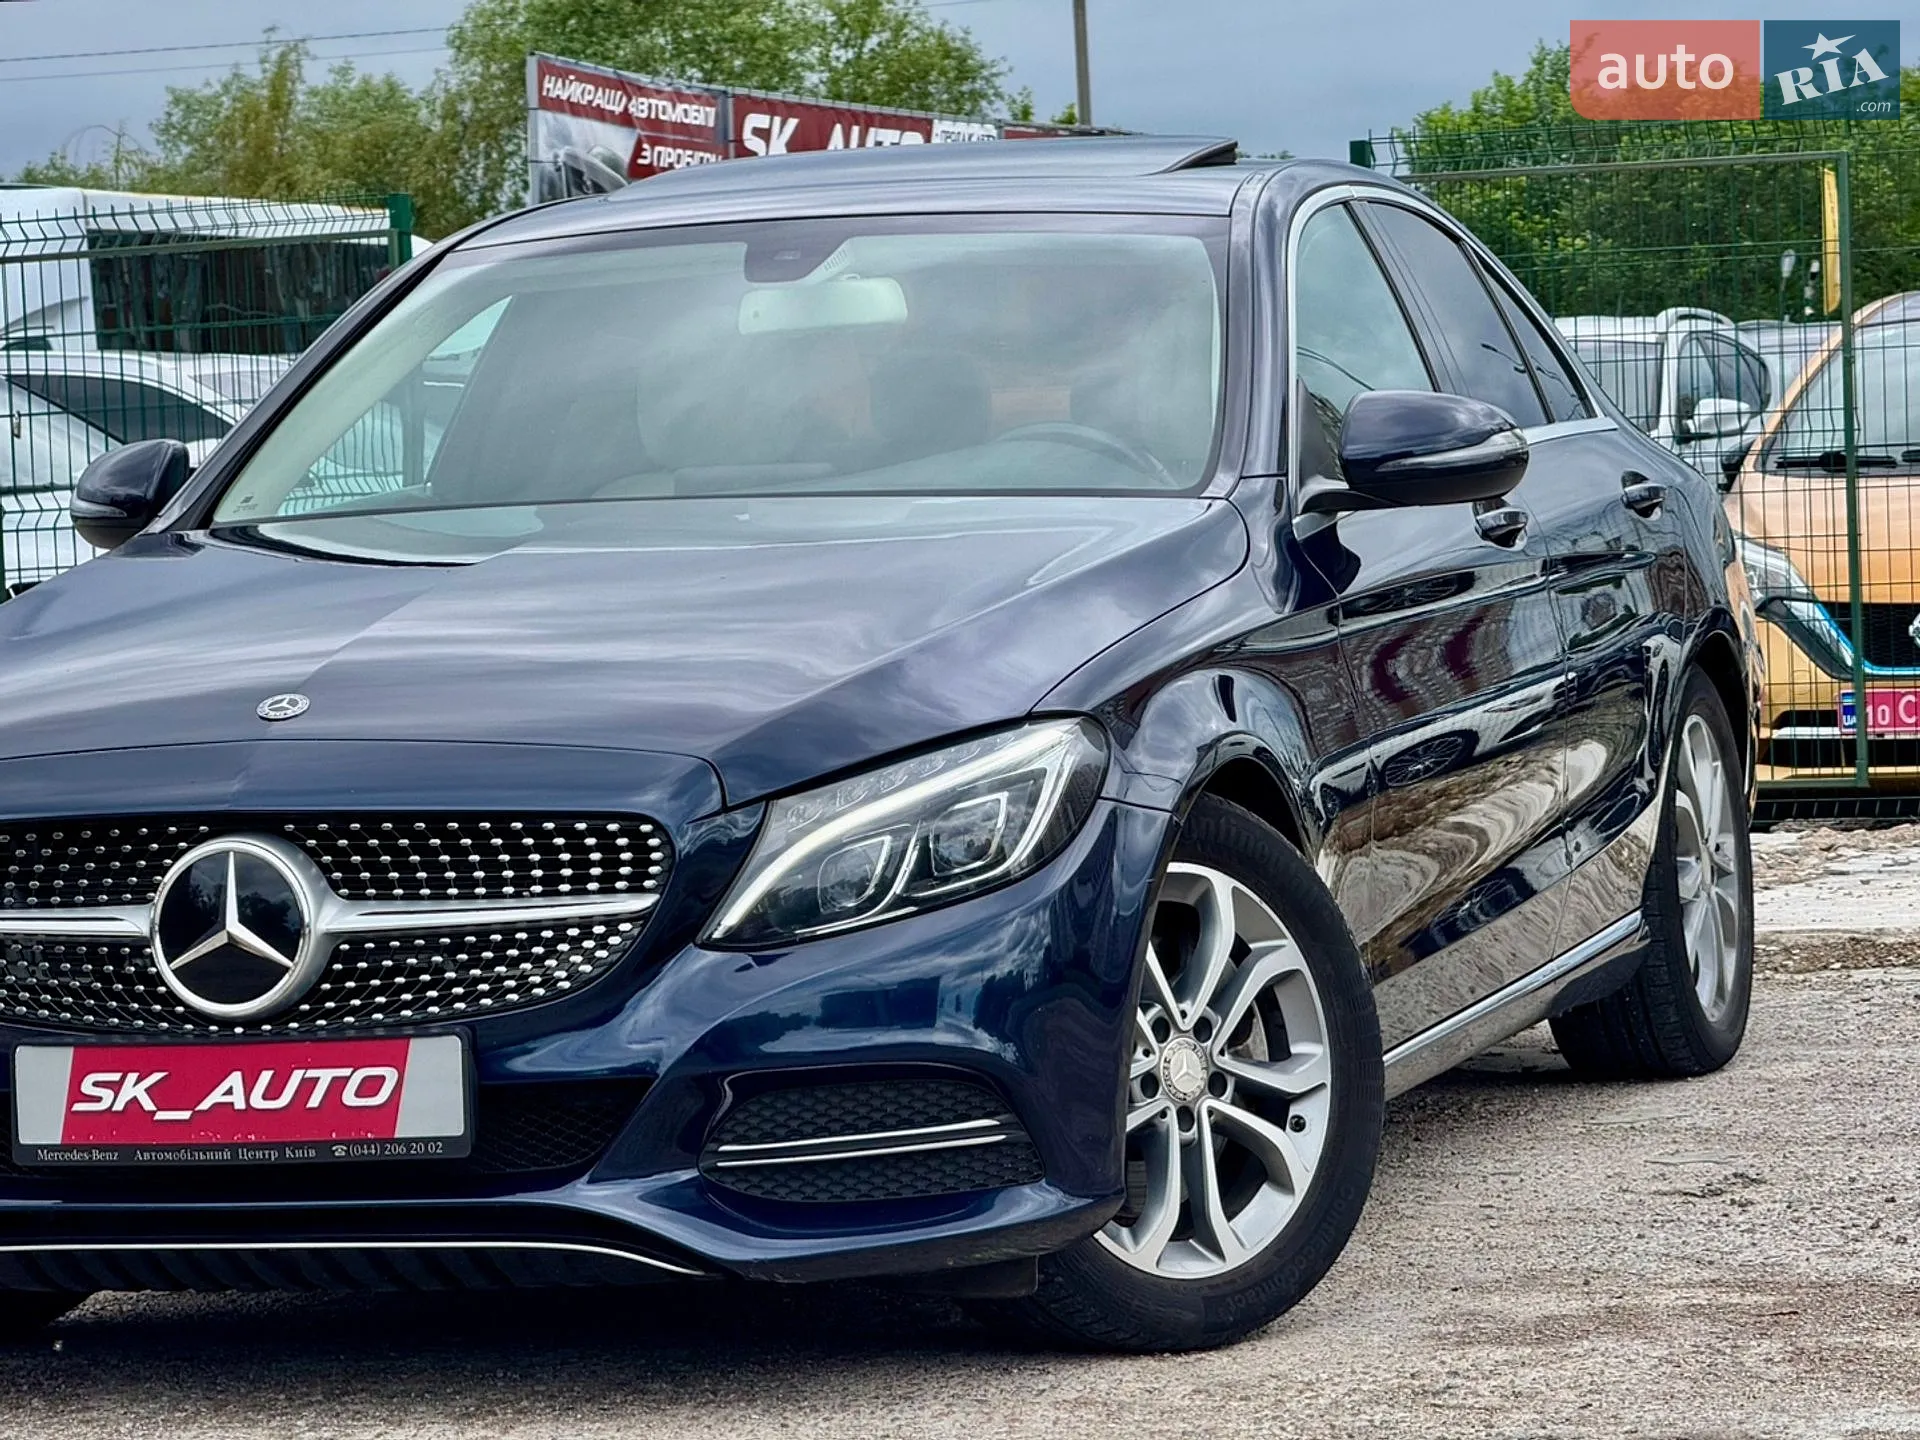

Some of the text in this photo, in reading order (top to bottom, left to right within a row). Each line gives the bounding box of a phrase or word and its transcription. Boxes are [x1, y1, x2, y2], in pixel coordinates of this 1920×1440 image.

[542, 75, 626, 115] НАЙКРАЩІ
[742, 113, 799, 157] SK
[71, 1065, 398, 1121] SK_AUTO
[37, 1141, 443, 1162] Mercedes-Benz Автомобільний Центр Київ (044) 206 20 02
